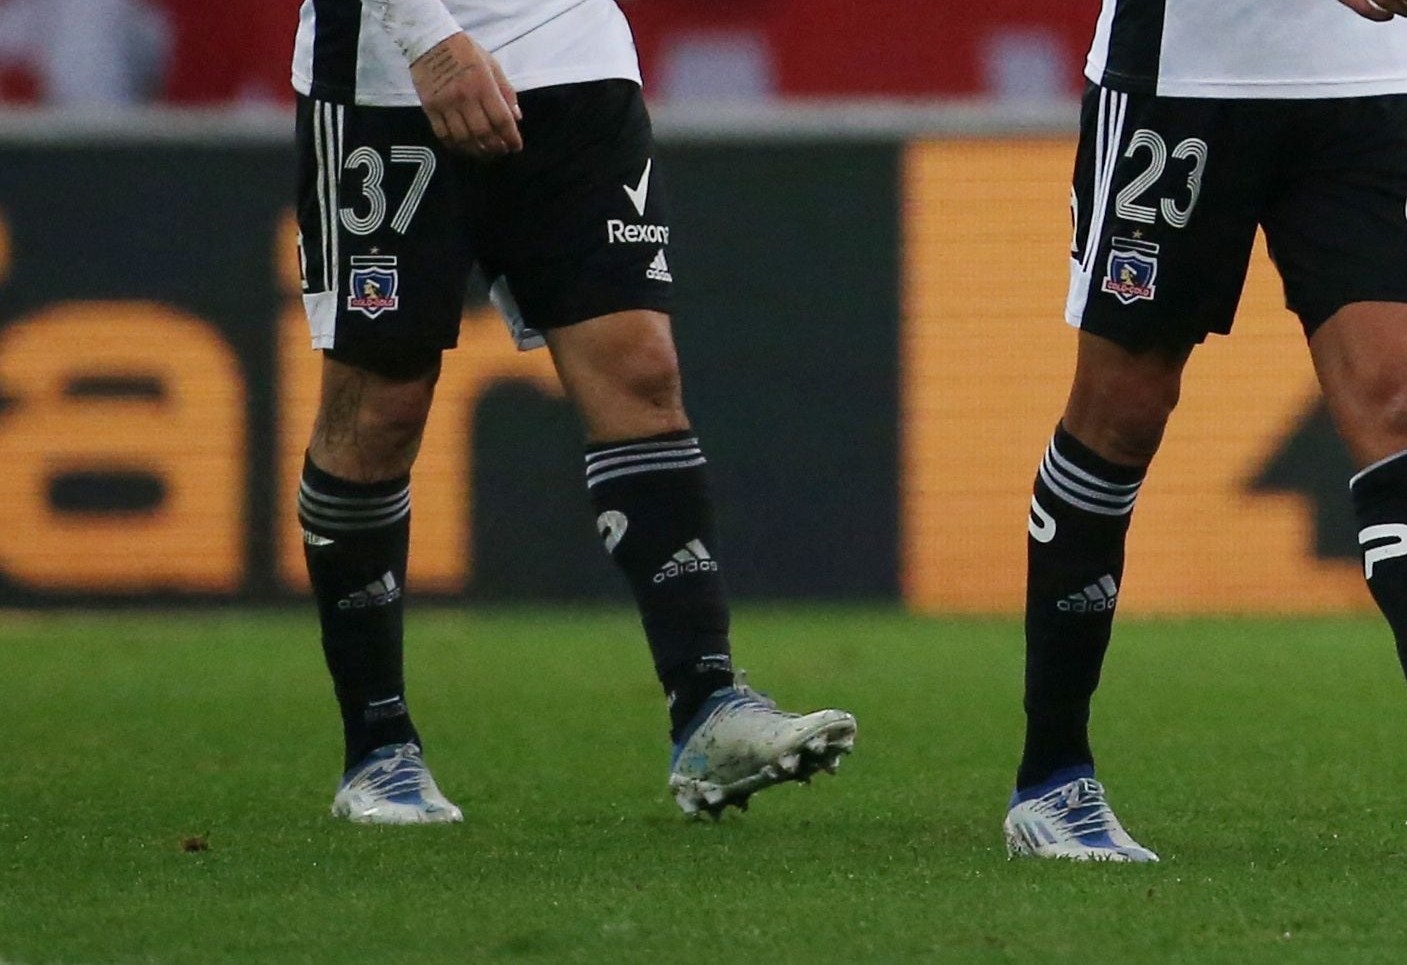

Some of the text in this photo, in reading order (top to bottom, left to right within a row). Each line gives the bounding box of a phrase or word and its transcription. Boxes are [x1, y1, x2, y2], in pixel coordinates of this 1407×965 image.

[339, 145, 437, 235] 37
[1115, 128, 1209, 228] 23
[653, 559, 719, 584] adidas
